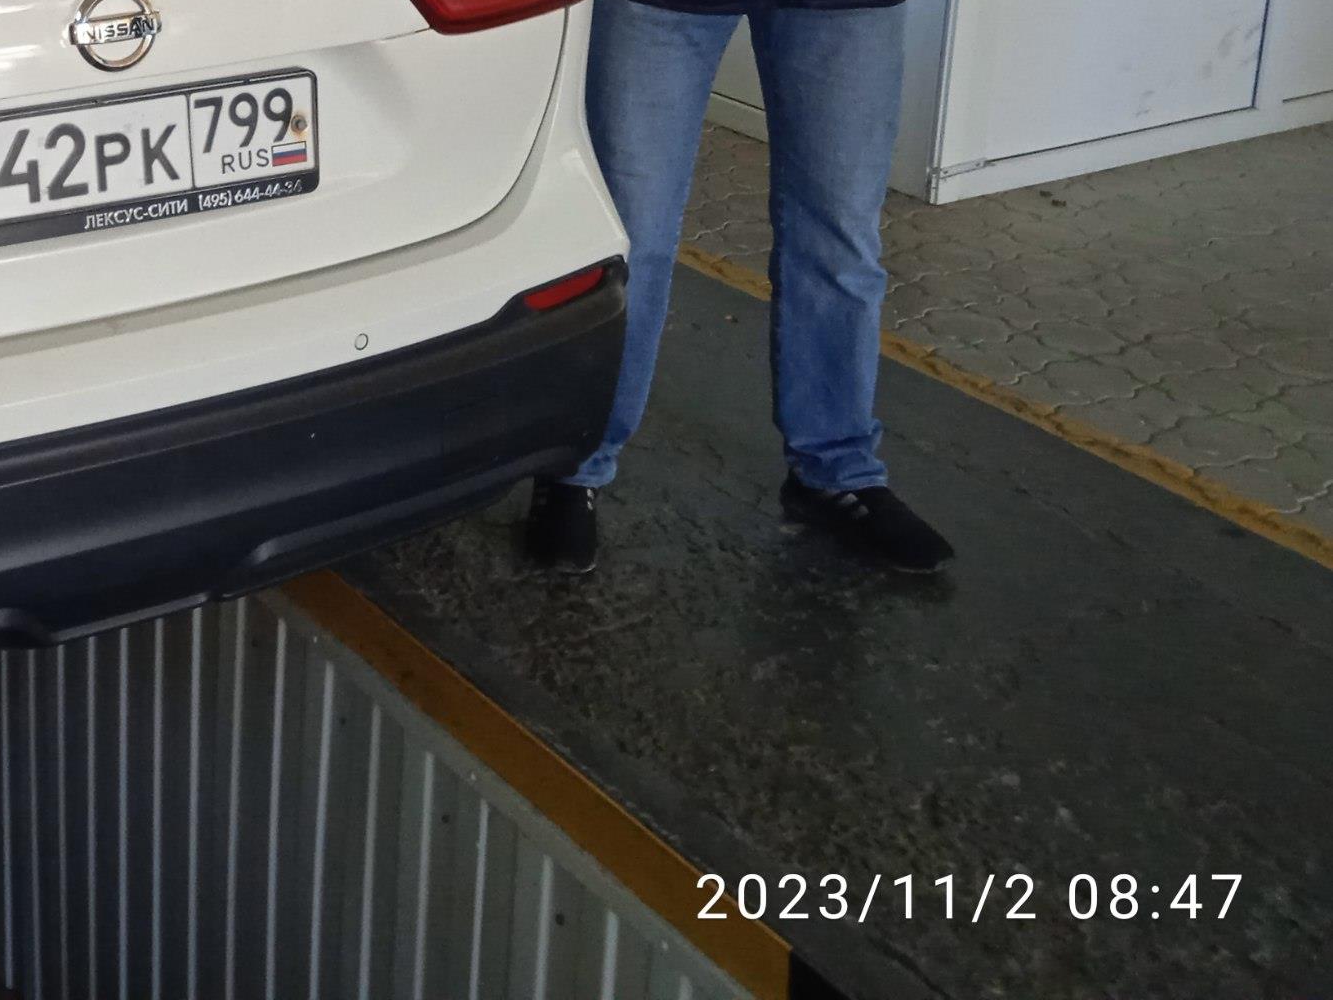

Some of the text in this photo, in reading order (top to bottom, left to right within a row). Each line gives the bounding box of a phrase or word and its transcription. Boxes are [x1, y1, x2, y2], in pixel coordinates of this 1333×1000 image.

[83, 15, 155, 40] NISSAN
[194, 87, 296, 153] 799
[221, 147, 270, 175] RUS
[83, 198, 189, 231] ЛЕКСУС-СИТИ
[198, 190, 233, 212] (495)
